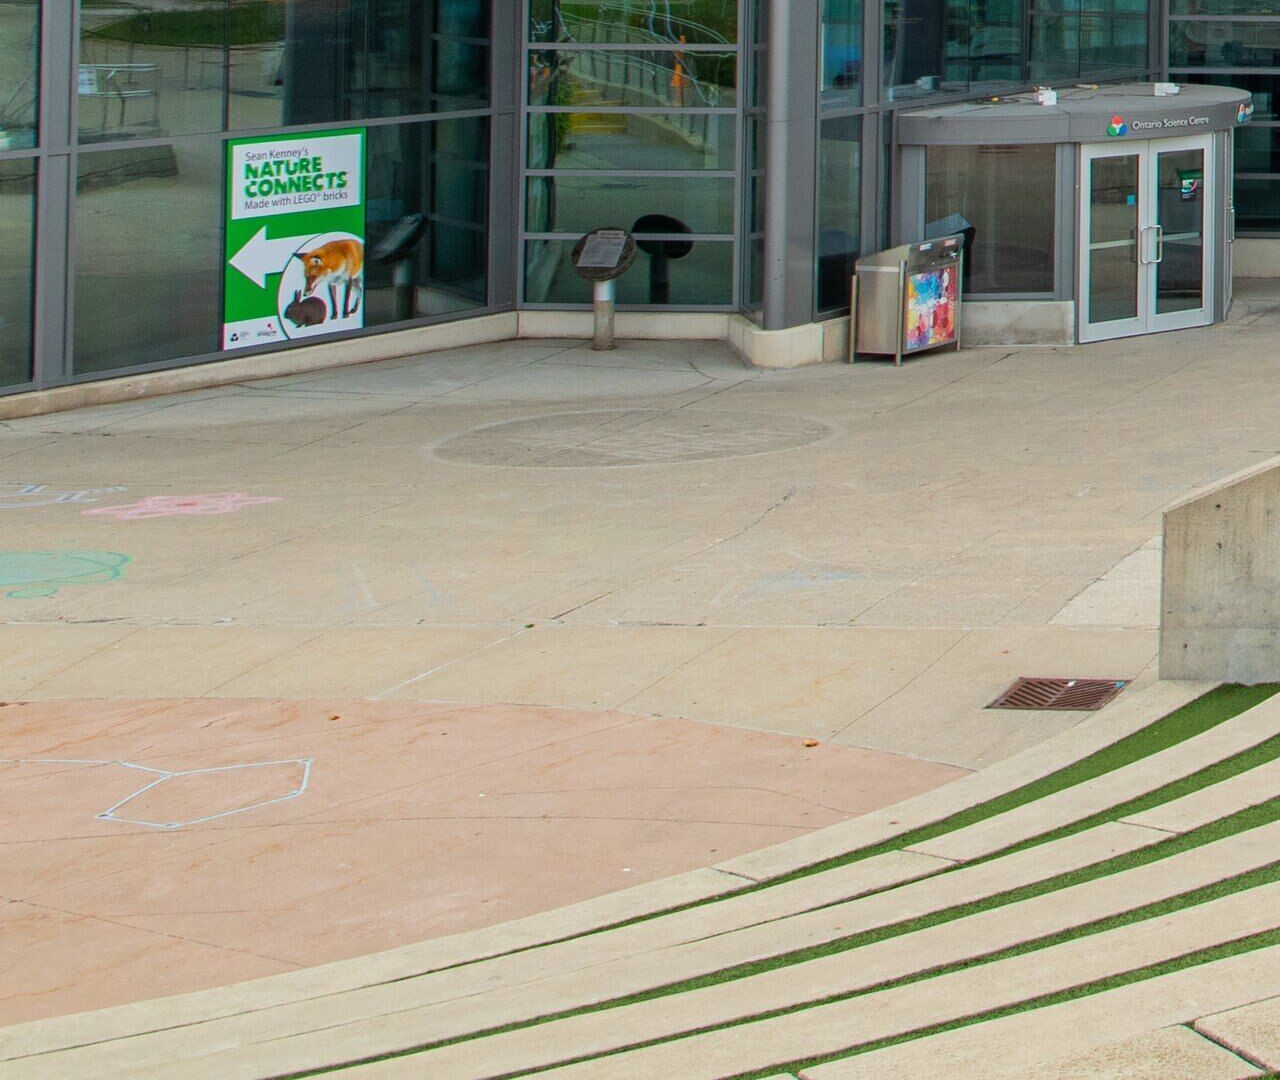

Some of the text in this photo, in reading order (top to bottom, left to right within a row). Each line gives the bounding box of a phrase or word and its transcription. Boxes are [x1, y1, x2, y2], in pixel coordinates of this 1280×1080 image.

[1132, 120, 1162, 130] Ontario
[1163, 118, 1188, 128] Science
[246, 147, 309, 161] Sean Kenney's
[245, 156, 322, 180] NATURE
[244, 171, 347, 198] CONNECTS
[245, 199, 270, 210] Made
[272, 196, 292, 207] with
[323, 190, 348, 201] bricks
